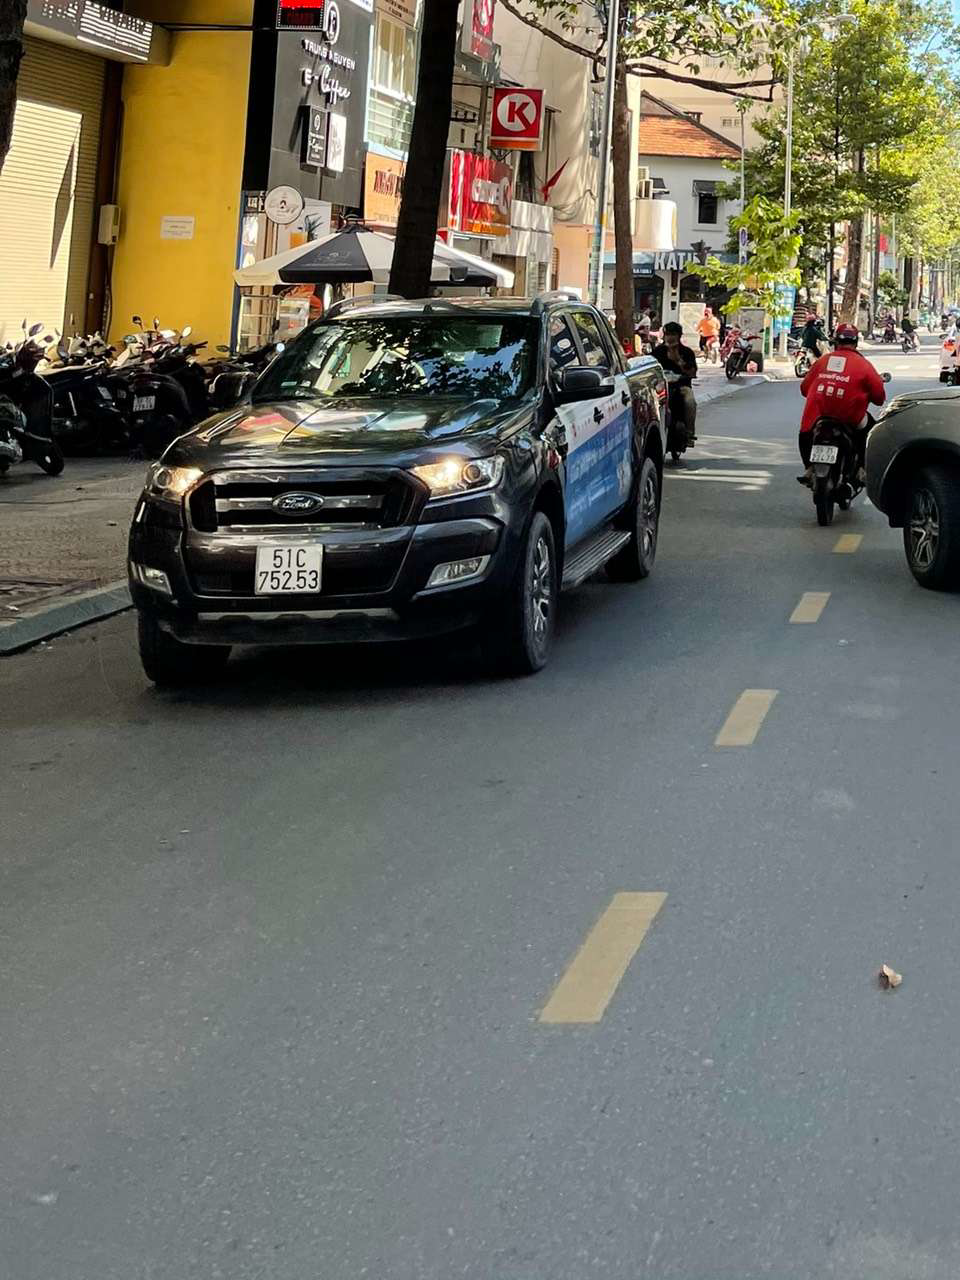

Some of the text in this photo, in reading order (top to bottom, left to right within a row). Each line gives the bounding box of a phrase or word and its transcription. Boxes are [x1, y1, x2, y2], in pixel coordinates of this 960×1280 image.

[304, 39, 328, 58] TRUNG
[508, 101, 530, 130] K
[281, 496, 314, 509] Ford
[272, 548, 307, 569] 51C
[258, 569, 319, 591] 752.53
